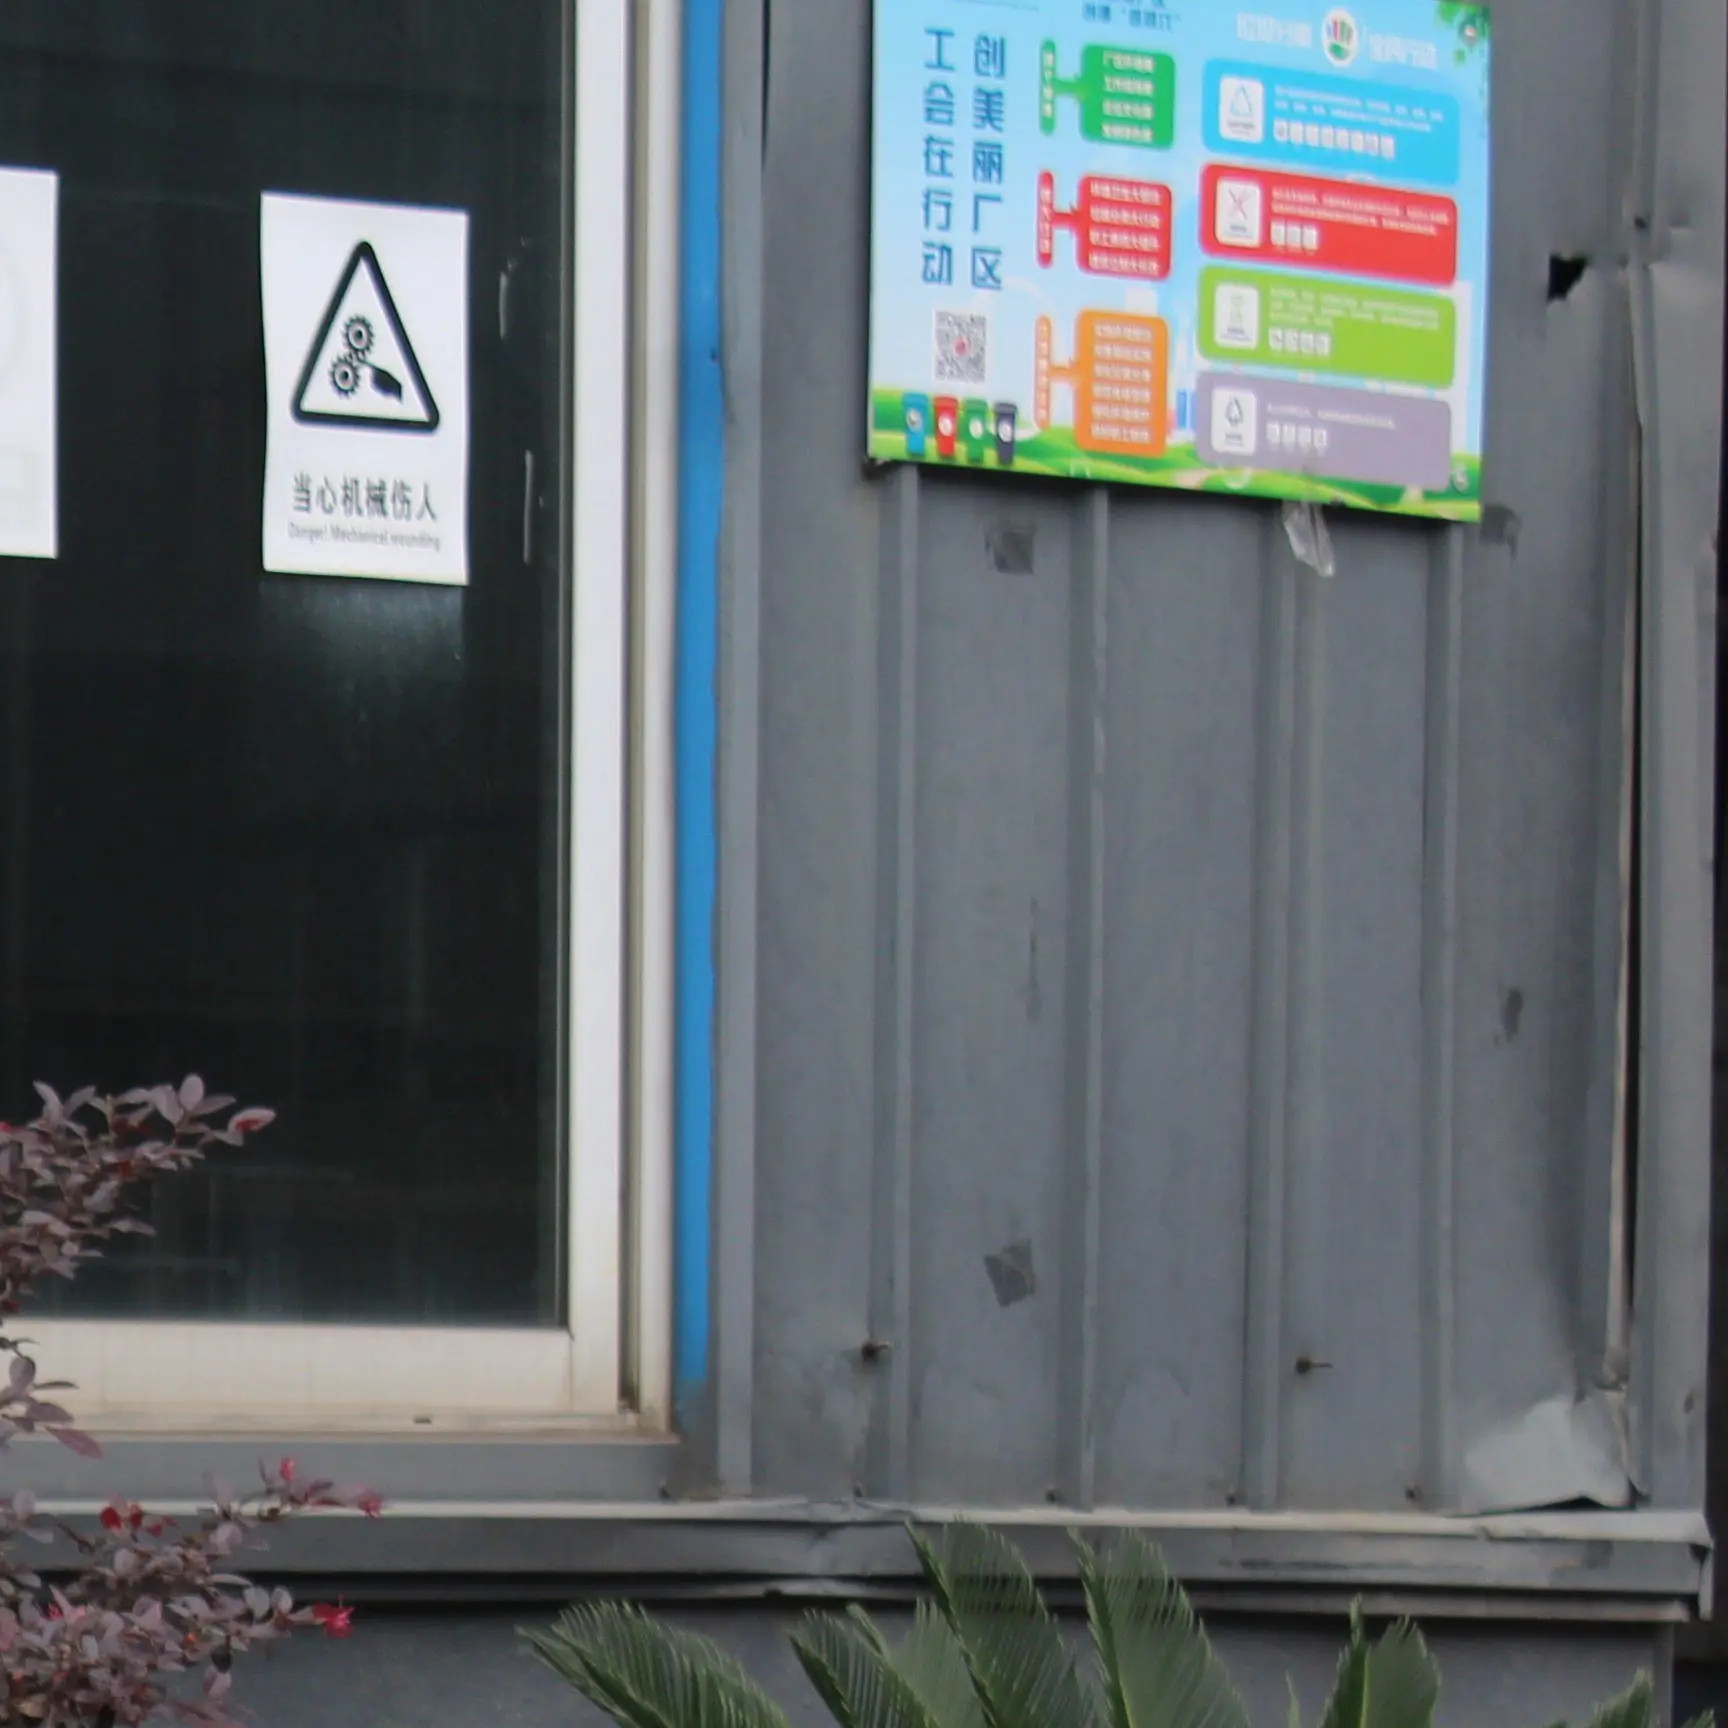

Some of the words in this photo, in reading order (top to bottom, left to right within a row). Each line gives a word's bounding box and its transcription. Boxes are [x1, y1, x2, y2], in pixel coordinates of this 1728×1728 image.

[922, 26, 955, 286] 工会在行动
[970, 32, 1005, 291] 创美丽厂区
[292, 471, 438, 523] 当心机械伤人
